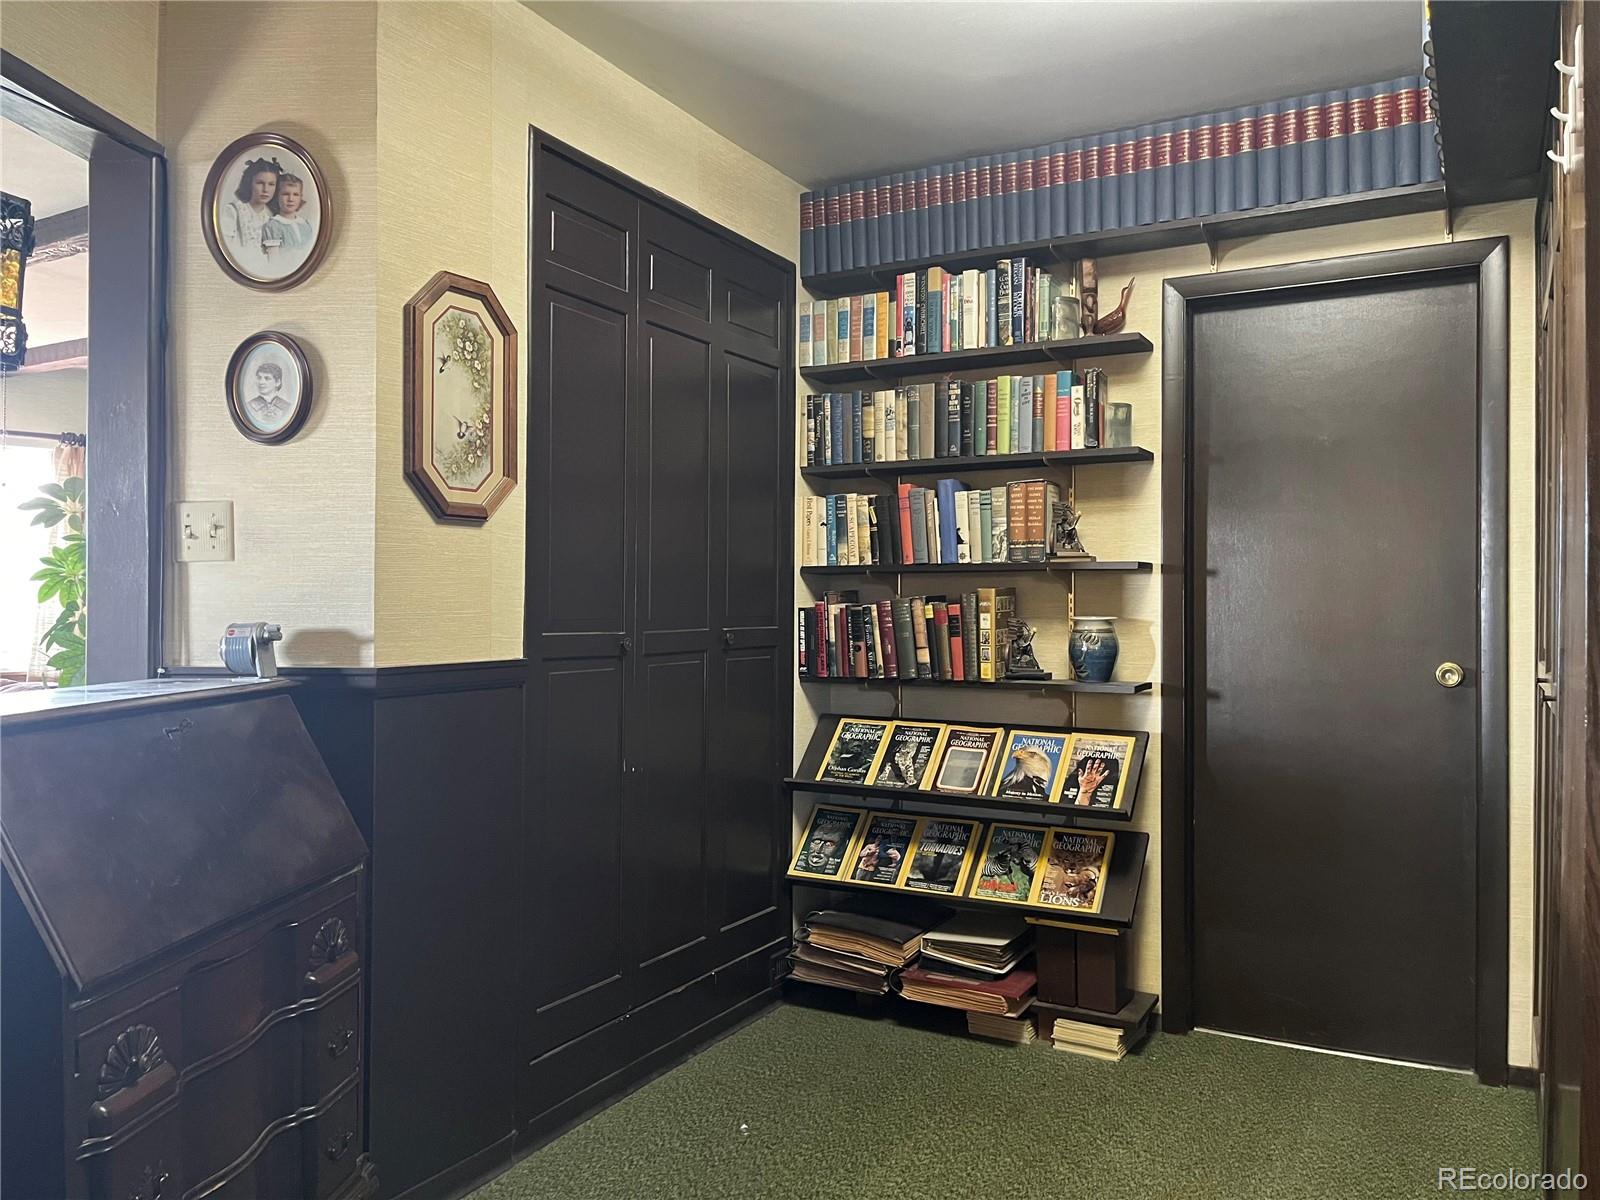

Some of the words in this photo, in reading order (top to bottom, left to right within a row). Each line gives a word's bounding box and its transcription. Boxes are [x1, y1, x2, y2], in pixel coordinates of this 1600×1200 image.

[841, 732, 881, 741] GEOGRAPHIC
[895, 735, 934, 744] GEOGRAPHIC
[1021, 737, 1056, 746] NATIONAL
[950, 739, 991, 748] GEOGRAPHIC
[1086, 744, 1118, 752] NATIONAL
[1076, 749, 1121, 760] GEOGRAPHIC
[932, 823, 964, 832] NATIONAL
[923, 830, 969, 840] GEOGRAPHIC
[1002, 829, 1035, 840] NATIONAL
[1062, 835, 1098, 845] NATIONAL
[920, 842, 965, 856] TORNADOES
[1052, 842, 1105, 854] GEOGRAPHIC
[1040, 893, 1080, 907] LIONS
